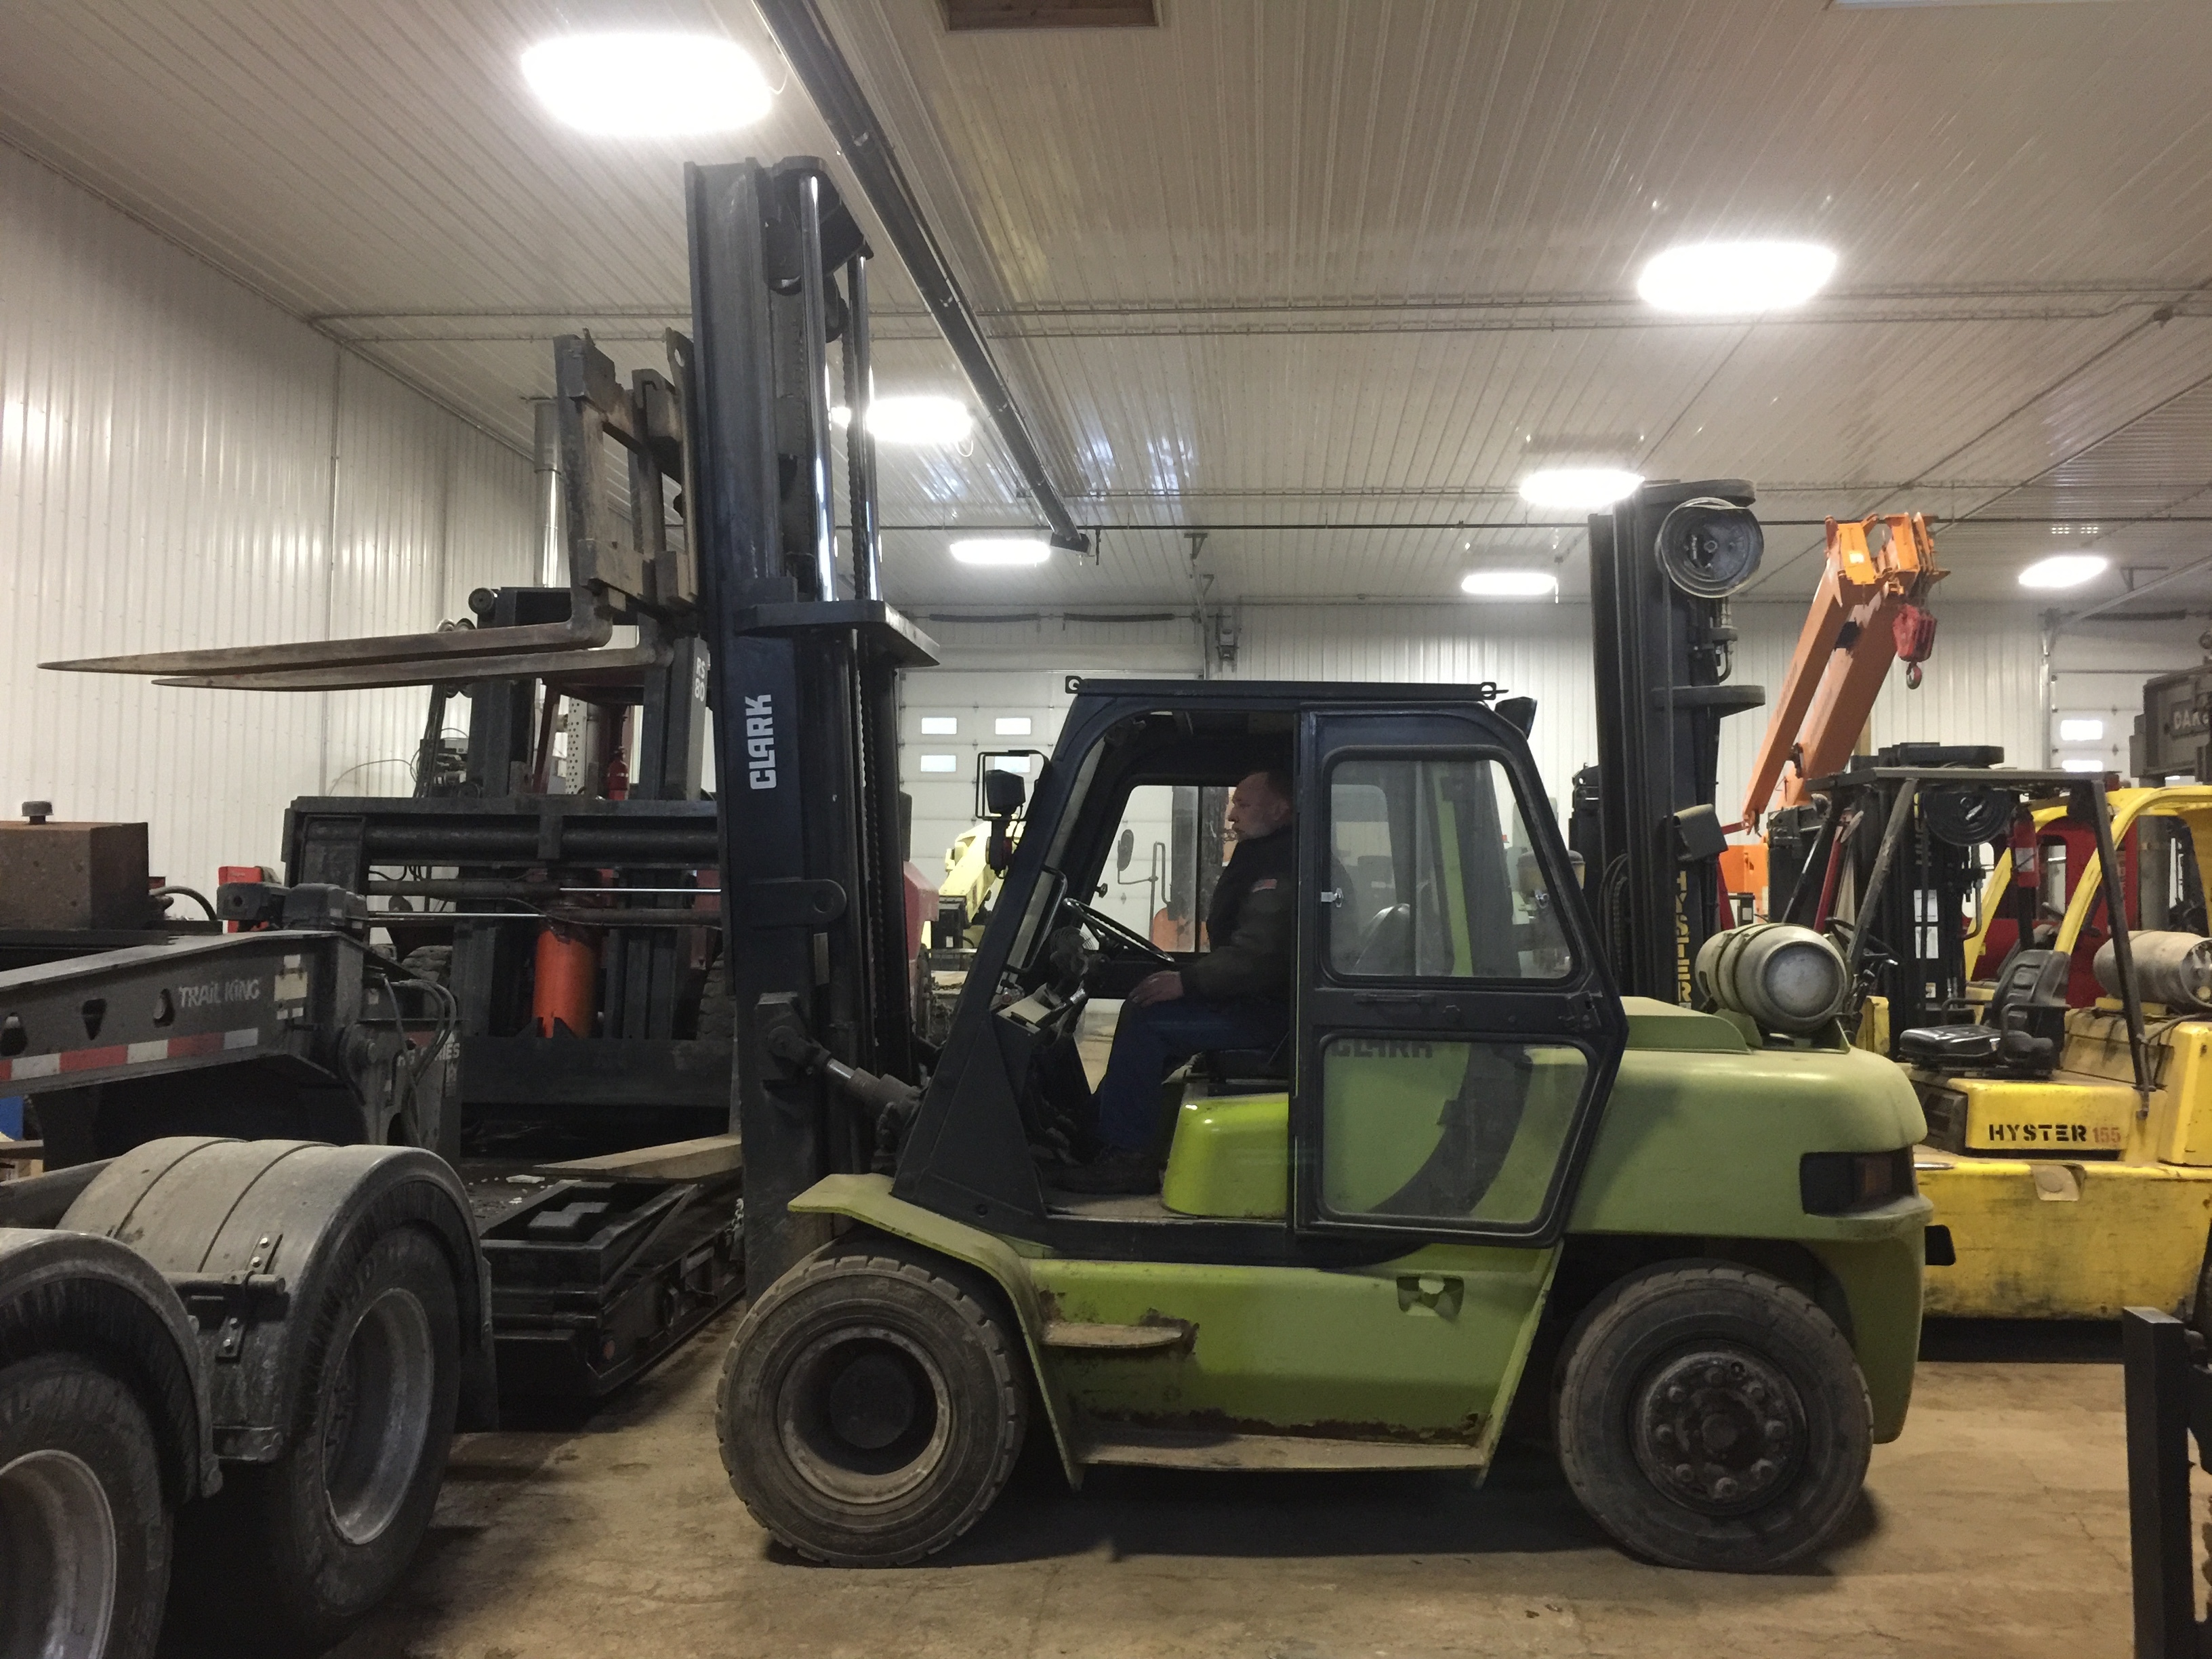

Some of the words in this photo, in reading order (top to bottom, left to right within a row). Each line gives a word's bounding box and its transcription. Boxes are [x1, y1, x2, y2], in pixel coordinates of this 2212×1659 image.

[696, 657, 705, 679] RS
[694, 678, 705, 701] 80
[745, 694, 777, 790] CLARK
[1989, 1124, 2087, 1142] HYSTER
[2092, 1126, 2121, 1143] 155
